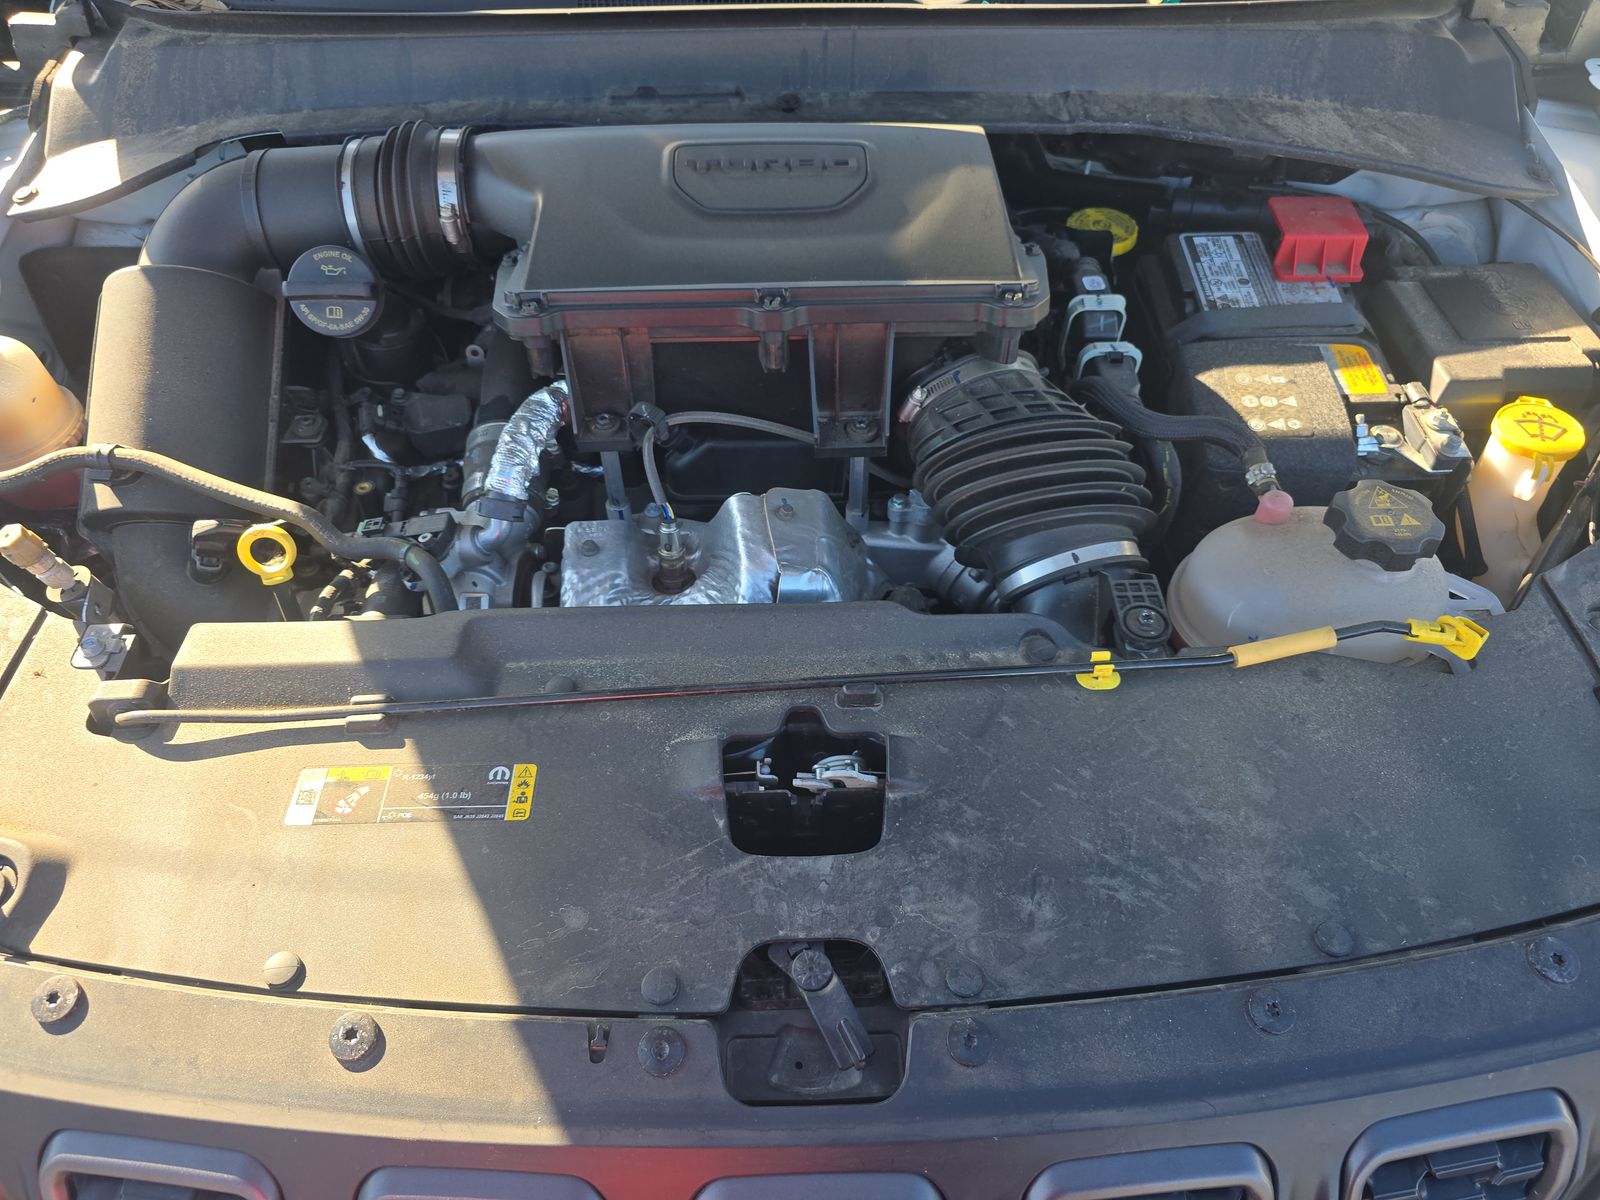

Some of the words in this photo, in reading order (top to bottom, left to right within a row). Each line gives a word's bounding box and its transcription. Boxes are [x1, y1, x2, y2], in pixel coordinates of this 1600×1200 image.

[313, 251, 340, 261] ENGINE
[341, 253, 353, 263] OIL
[299, 304, 310, 316] API
[417, 792, 439, 801] 454g
[441, 792, 458, 800] (1.0
[460, 791, 472, 800] lb)
